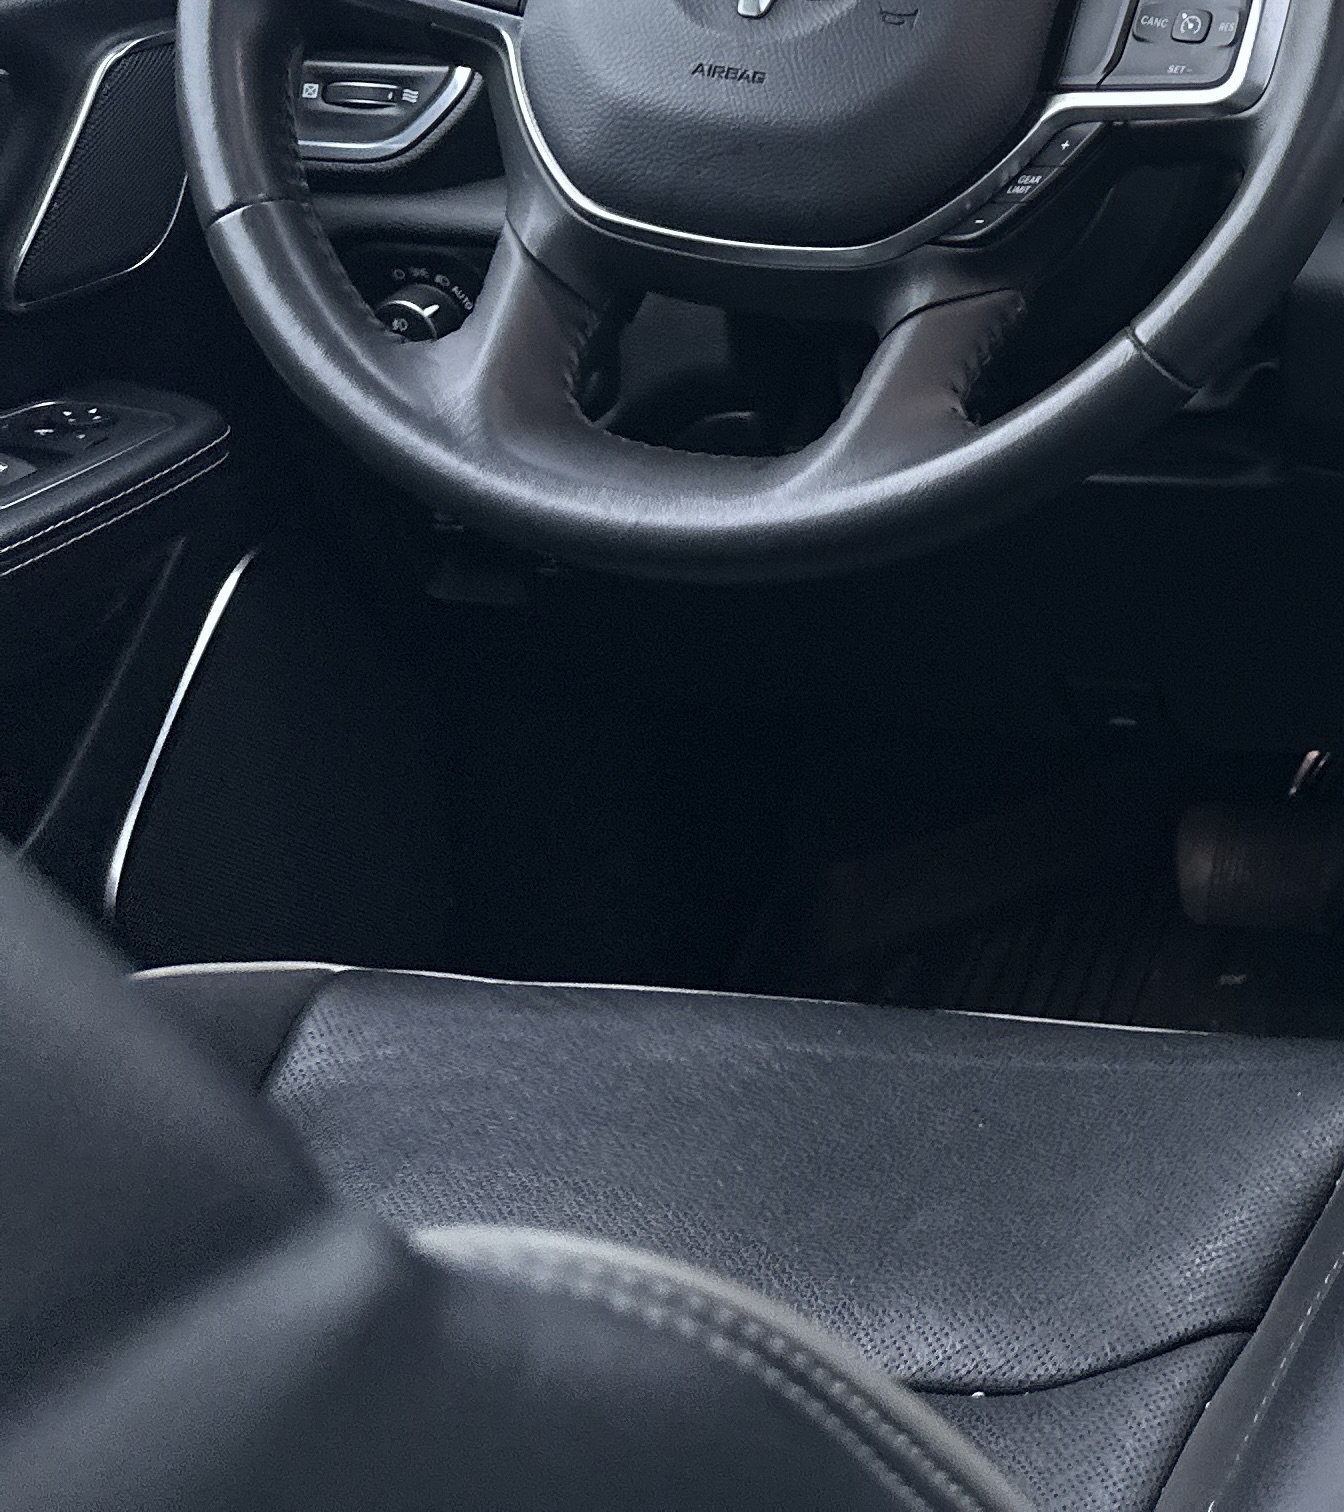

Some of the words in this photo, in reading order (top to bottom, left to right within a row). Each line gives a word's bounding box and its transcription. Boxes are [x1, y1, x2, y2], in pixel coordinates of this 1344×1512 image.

[1141, 15, 1169, 29] CANC
[1218, 22, 1236, 32] RES
[691, 62, 767, 85] AIRBAG
[1018, 174, 1042, 185] GEAR
